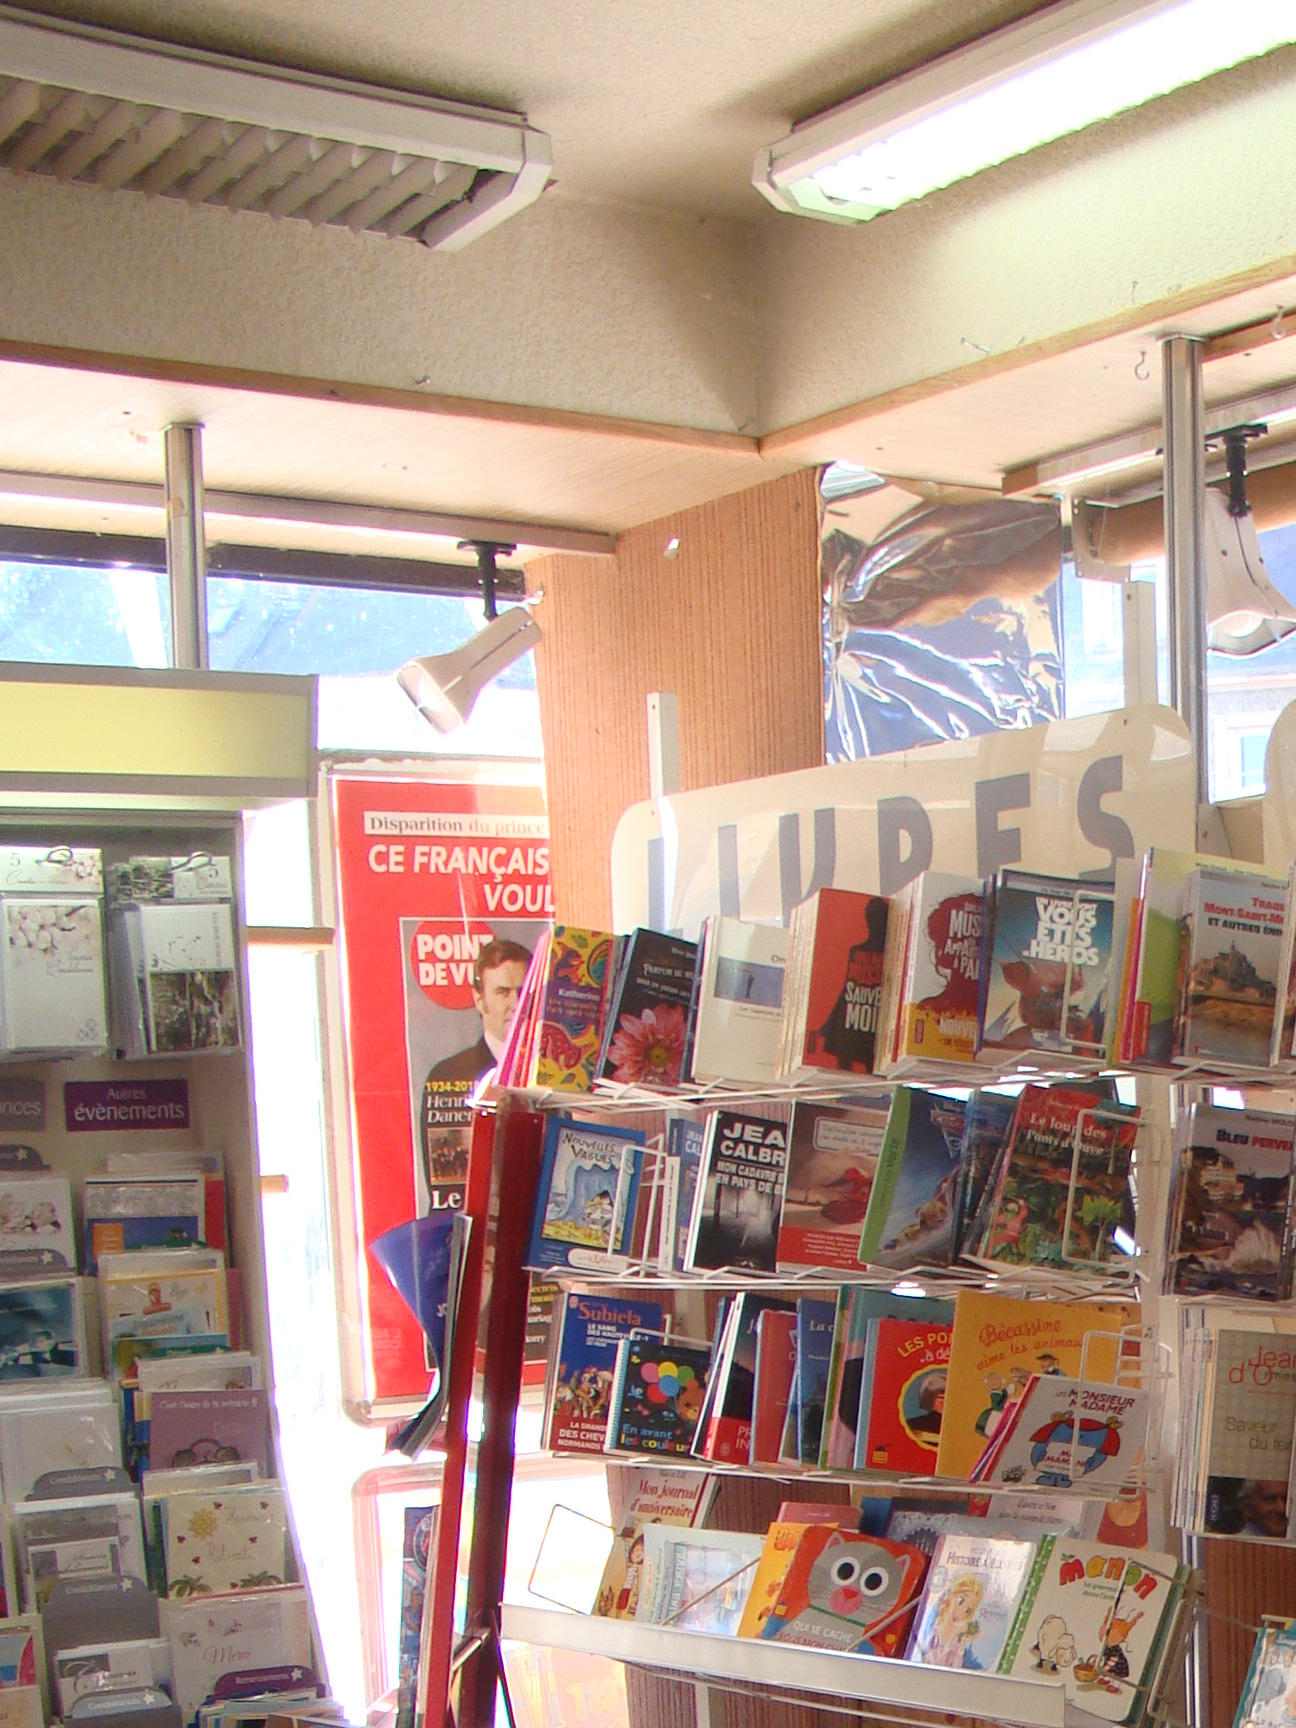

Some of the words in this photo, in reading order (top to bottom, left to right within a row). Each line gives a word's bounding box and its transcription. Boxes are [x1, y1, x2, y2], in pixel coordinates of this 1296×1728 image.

[370, 816, 463, 834] Disparition
[468, 818, 490, 833] du
[495, 820, 545, 838] prince
[368, 844, 405, 874] CE
[413, 845, 550, 883] FRANÇAIS
[419, 964, 447, 986] DE
[107, 1088, 146, 1100] Autres
[75, 1103, 185, 1122] évènements
[562, 1131, 617, 1152] NOUVELLES
[1216, 1130, 1249, 1147] BLEU
[717, 1161, 735, 1174] MON
[716, 1172, 730, 1185] EN
[731, 1175, 756, 1190] PAYS
[758, 1179, 772, 1193] DE
[979, 1318, 1062, 1347] Bécassine
[898, 1337, 924, 1358] LES
[558, 1429, 577, 1440] DES
[639, 1479, 657, 1497] Mon
[657, 1480, 701, 1502] journal
[793, 1619, 809, 1634] QUI
